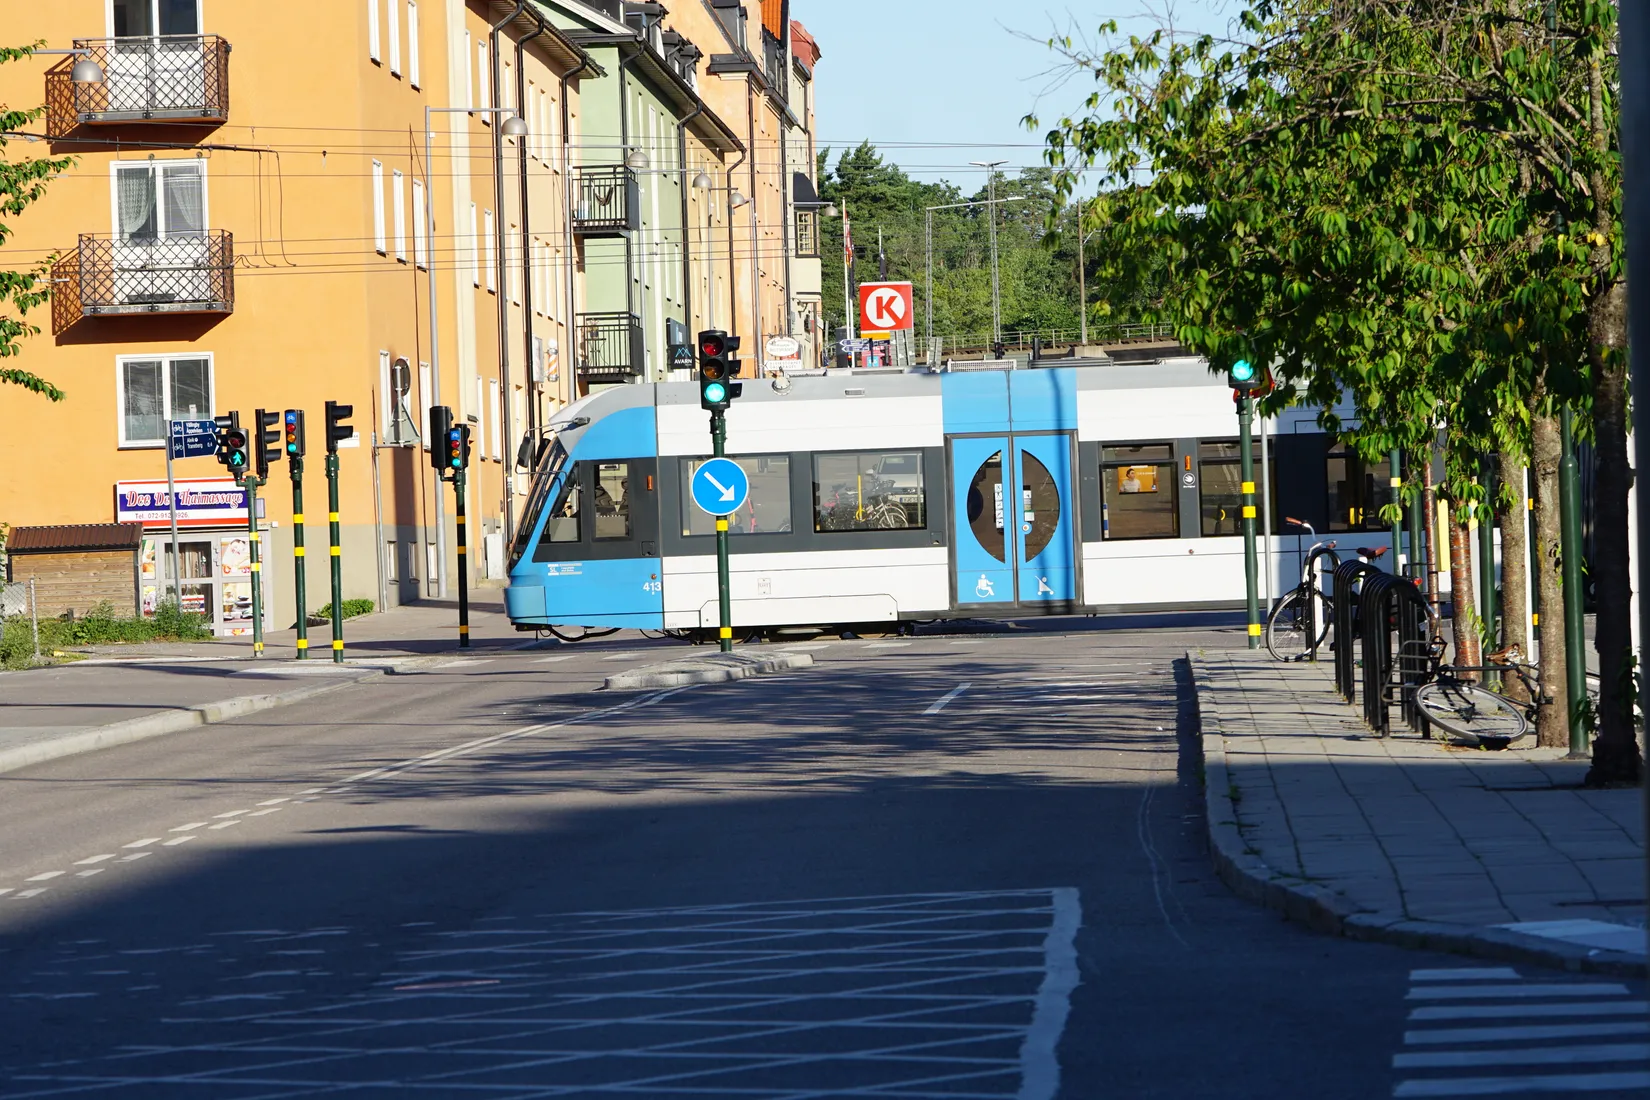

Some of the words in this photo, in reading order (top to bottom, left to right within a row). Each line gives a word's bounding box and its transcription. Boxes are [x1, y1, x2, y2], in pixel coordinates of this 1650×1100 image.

[875, 295, 901, 323] K
[126, 490, 151, 507] Dee
[154, 491, 176, 505] De
[179, 488, 243, 509] Thaimassage
[643, 581, 662, 592] 413
